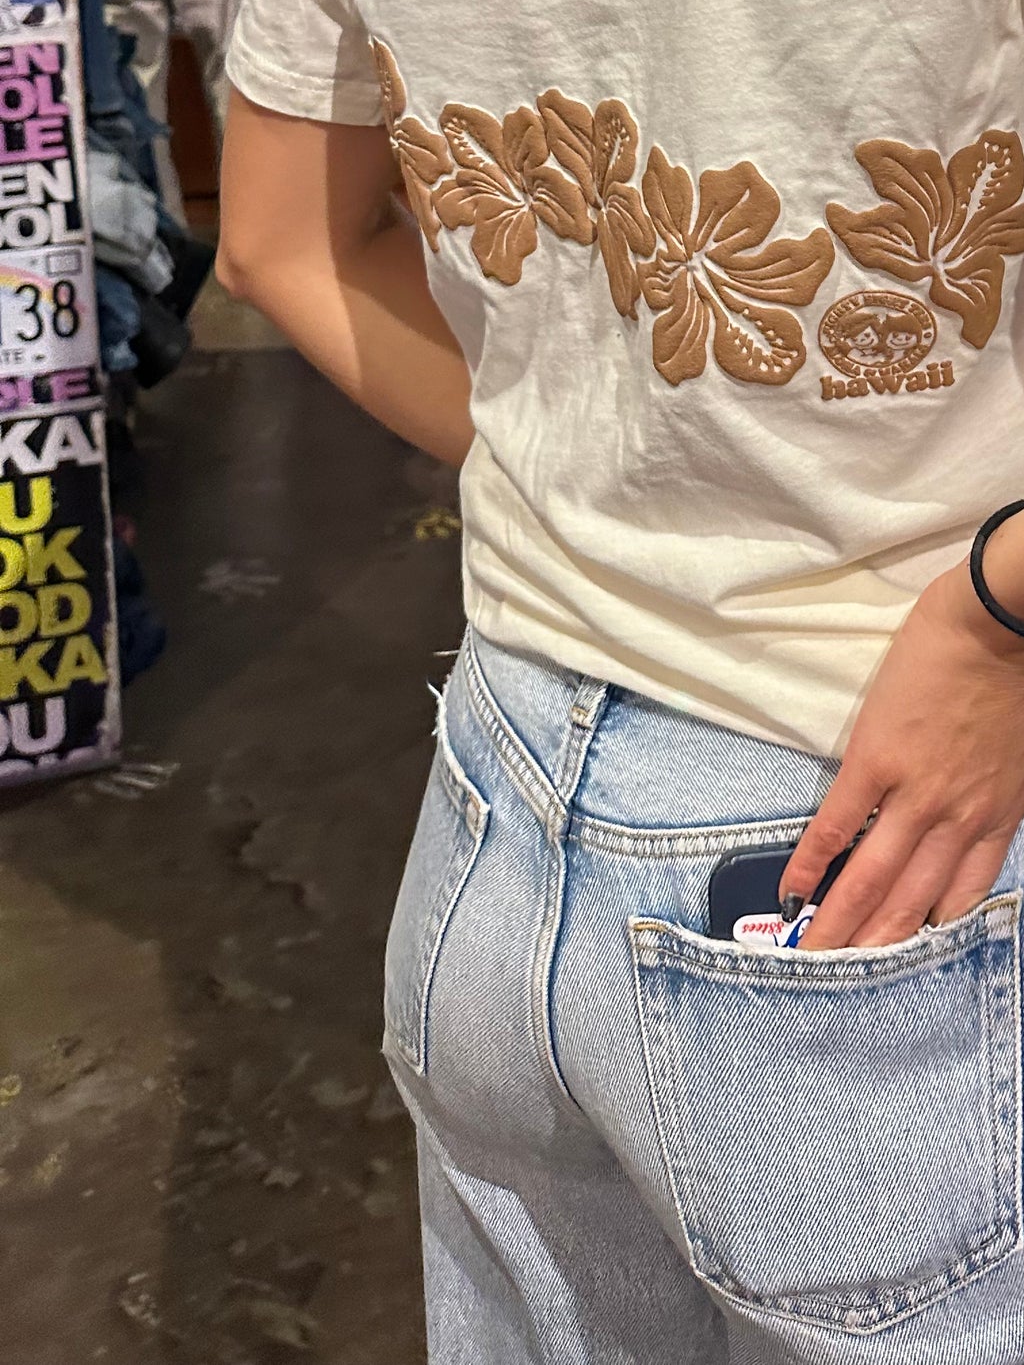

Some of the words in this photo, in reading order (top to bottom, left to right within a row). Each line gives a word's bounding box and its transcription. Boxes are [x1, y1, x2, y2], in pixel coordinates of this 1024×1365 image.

[0, 202, 85, 249] OL
[15, 280, 79, 342] 38
[0, 348, 24, 364] TE
[0, 475, 53, 534] U
[0, 582, 92, 647] OD
[0, 634, 108, 702] KA
[0, 696, 67, 756] U
